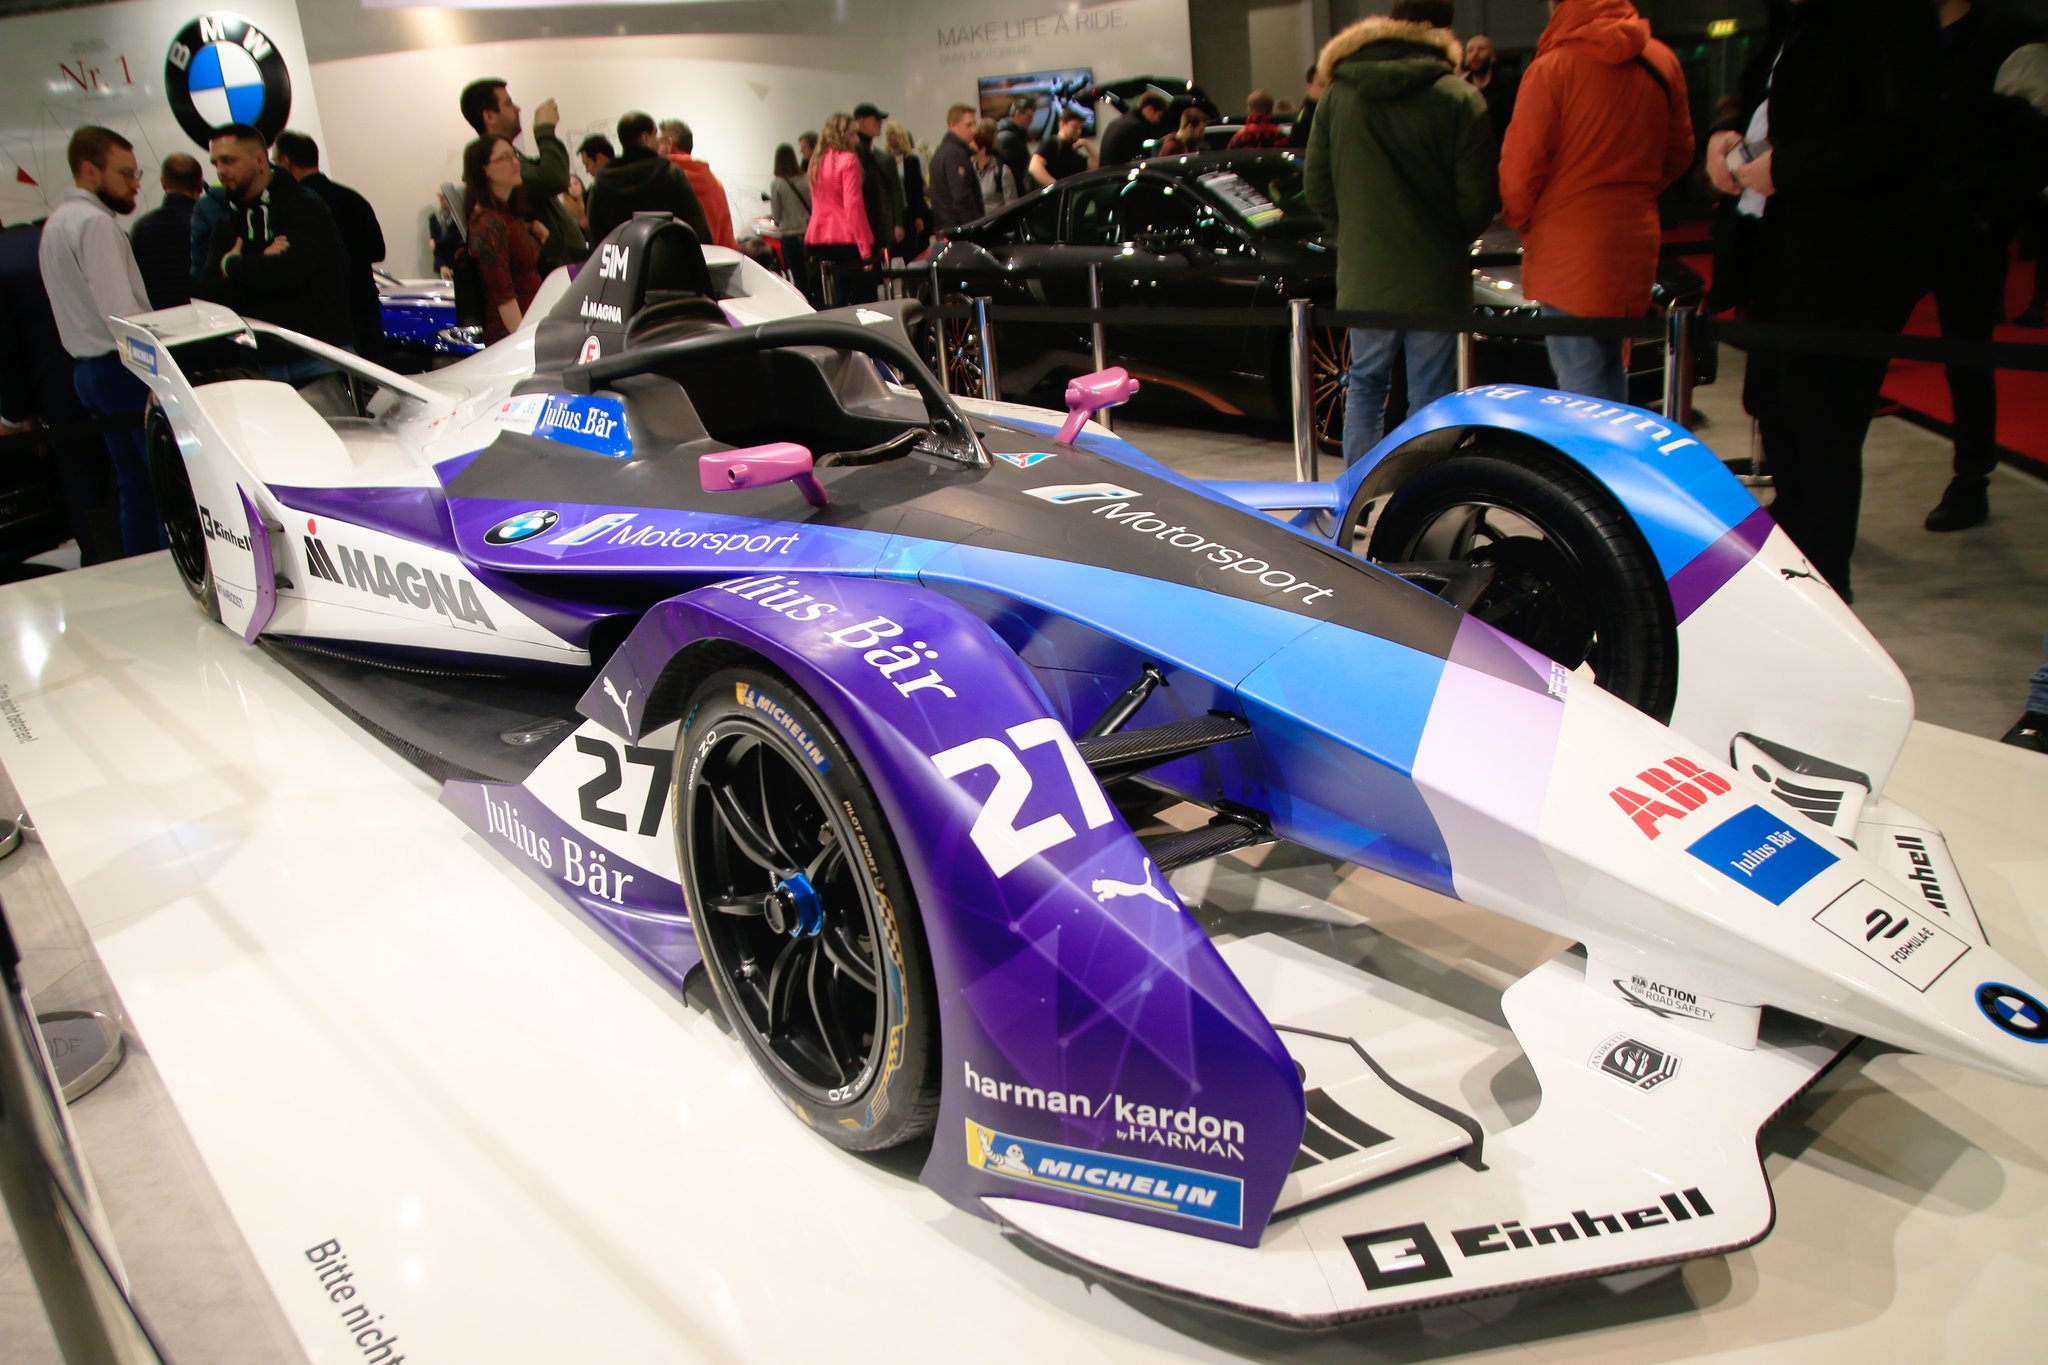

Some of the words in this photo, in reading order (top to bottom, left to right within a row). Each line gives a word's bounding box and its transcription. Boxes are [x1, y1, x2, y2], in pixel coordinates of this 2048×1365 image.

[168, 15, 273, 72] BMW
[938, 21, 997, 47] MAKE
[1005, 16, 1047, 40] LIFE
[1054, 14, 1070, 34] A
[599, 243, 630, 281] SIM
[588, 301, 622, 324] MAGNA
[539, 400, 582, 432] Julius
[582, 406, 618, 439] Bär
[607, 524, 800, 555] Motorsport
[1092, 501, 1334, 606] Motorsport
[337, 544, 498, 632] MAGNA
[824, 615, 957, 698] Bär
[757, 694, 826, 765] MICHELIN
[575, 735, 675, 838] 27
[930, 717, 1115, 879] 27
[1608, 756, 1732, 841] ABB
[481, 784, 553, 869] Julius
[561, 837, 634, 905] Bär
[843, 800, 863, 832] PILOT
[858, 834, 879, 874] SPORT
[1730, 842, 1777, 877] Julius
[1766, 829, 1798, 850] Bär
[1630, 985, 1645, 995] FOR
[1646, 990, 1674, 1007] ROAD
[1675, 1001, 1716, 1020] SAFETY
[1631, 975, 1648, 989] FIA
[1650, 982, 1697, 1005] ACTION
[1037, 1158, 1218, 1208] MICHELIN
[1450, 1186, 1715, 1258] Einhell
[305, 1237, 356, 1303] Bitte
[341, 1303, 406, 1365] nicht
